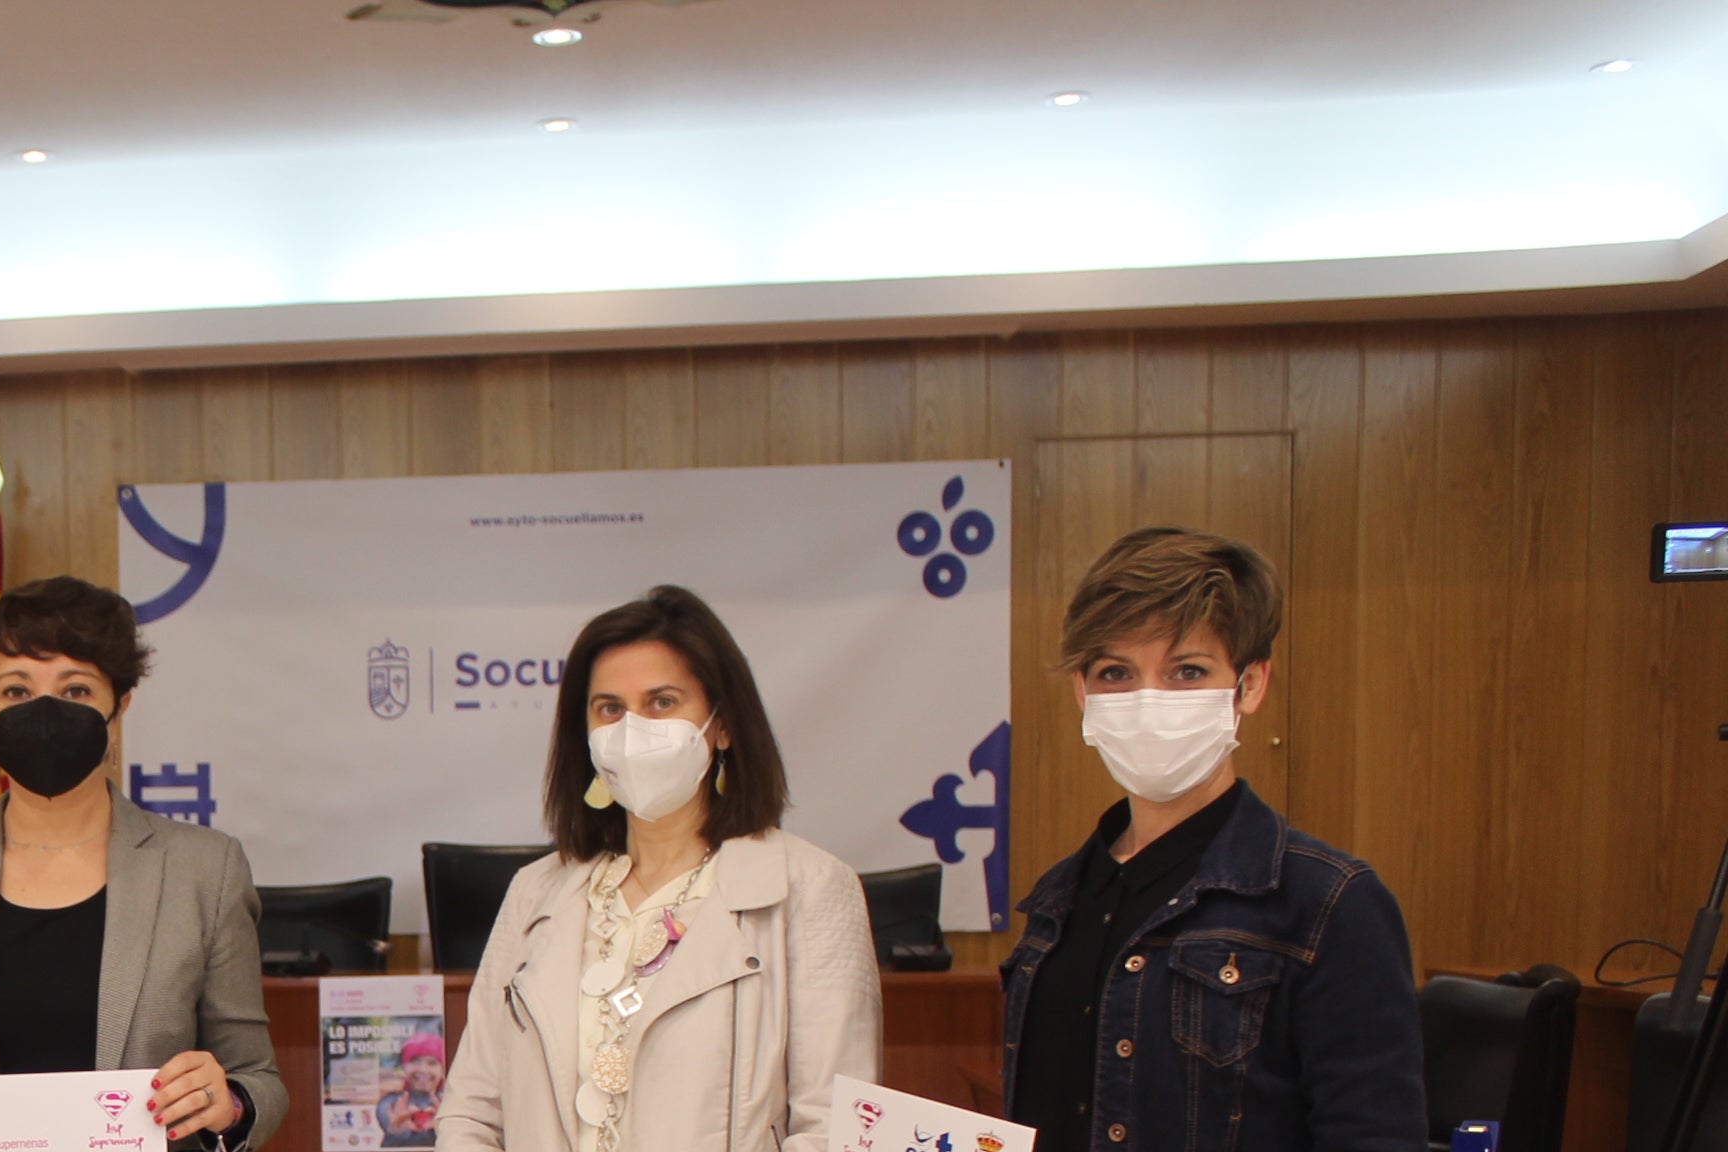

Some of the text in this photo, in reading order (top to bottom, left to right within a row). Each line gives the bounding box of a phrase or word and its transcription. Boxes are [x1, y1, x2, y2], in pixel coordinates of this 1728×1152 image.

[455, 652, 565, 687] Socu
[329, 1025, 346, 1039] LO
[329, 1040, 346, 1054] ES
